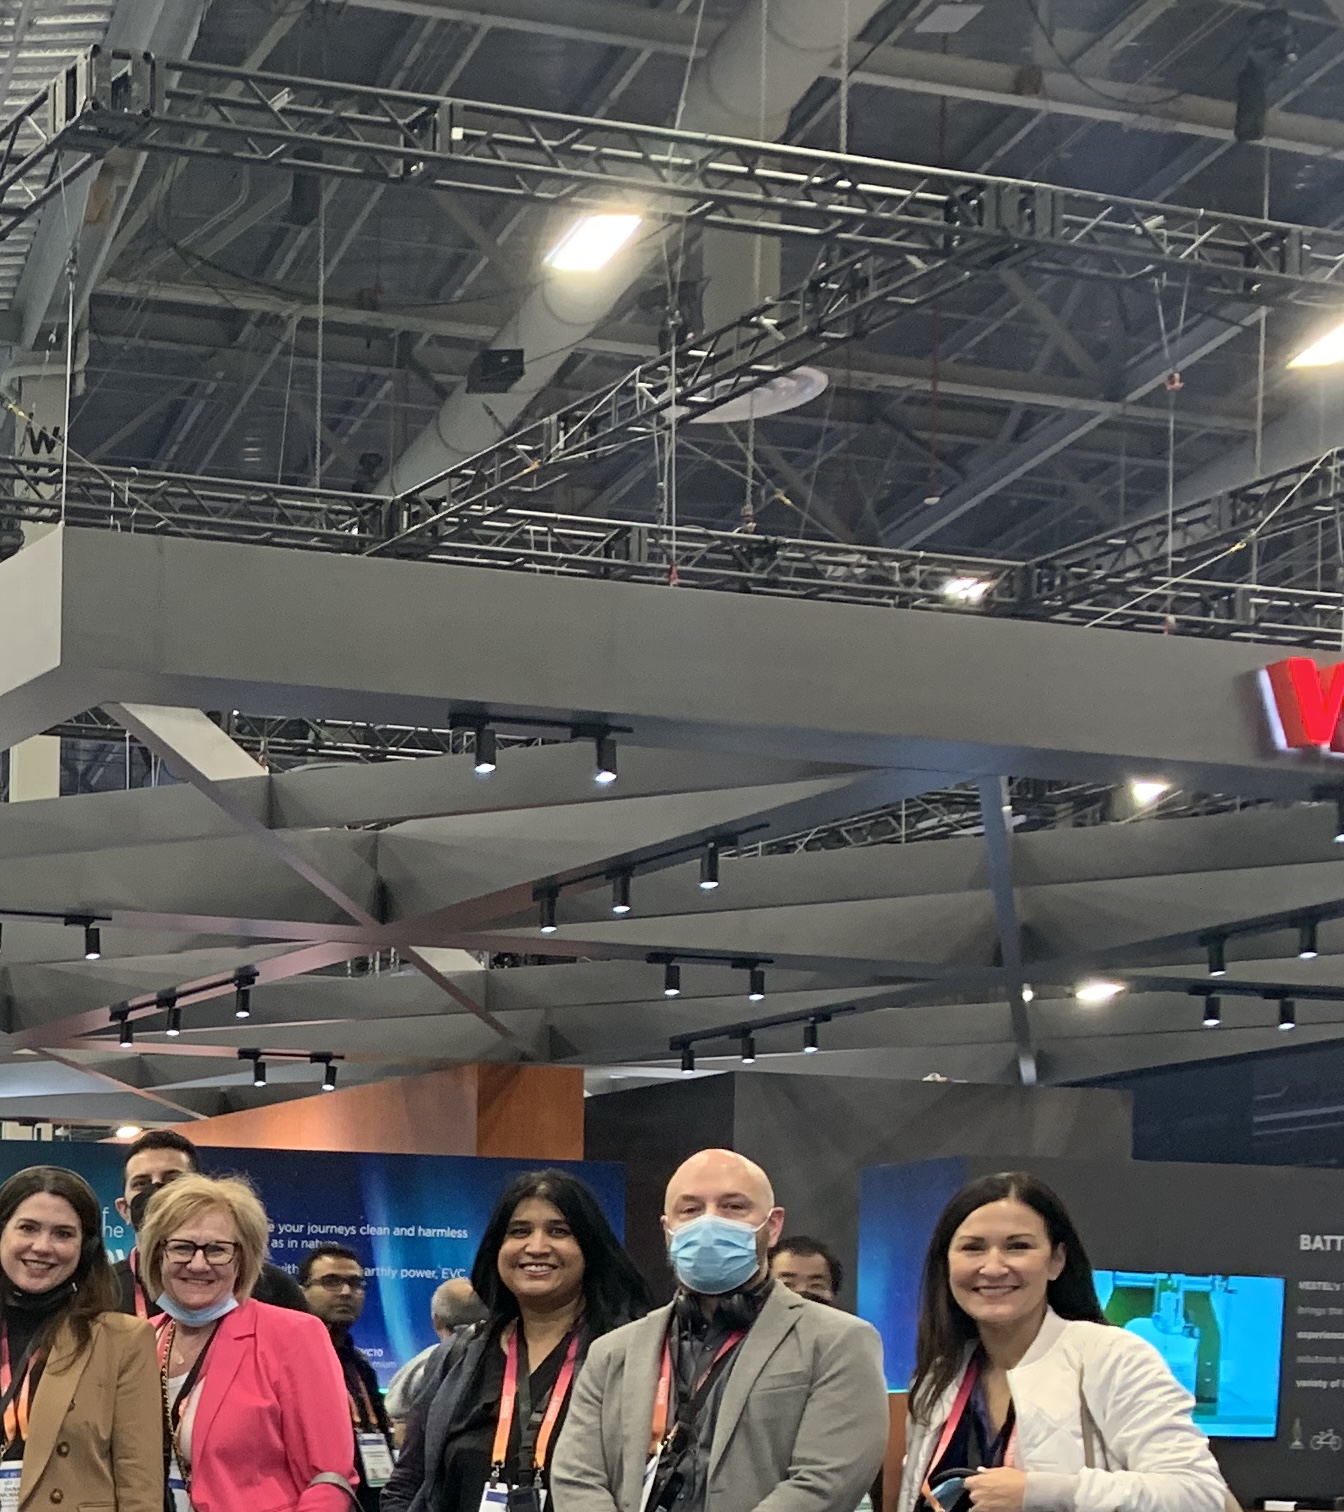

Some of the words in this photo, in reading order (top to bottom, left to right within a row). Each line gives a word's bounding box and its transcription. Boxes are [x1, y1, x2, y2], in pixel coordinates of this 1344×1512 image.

[278, 1223, 305, 1234] your
[307, 1222, 356, 1236] journeys
[359, 1224, 390, 1235] clean
[393, 1225, 415, 1236] and
[418, 1225, 468, 1238] harmless
[271, 1239, 284, 1248] as
[287, 1237, 298, 1248] in
[364, 1266, 398, 1279] arthly
